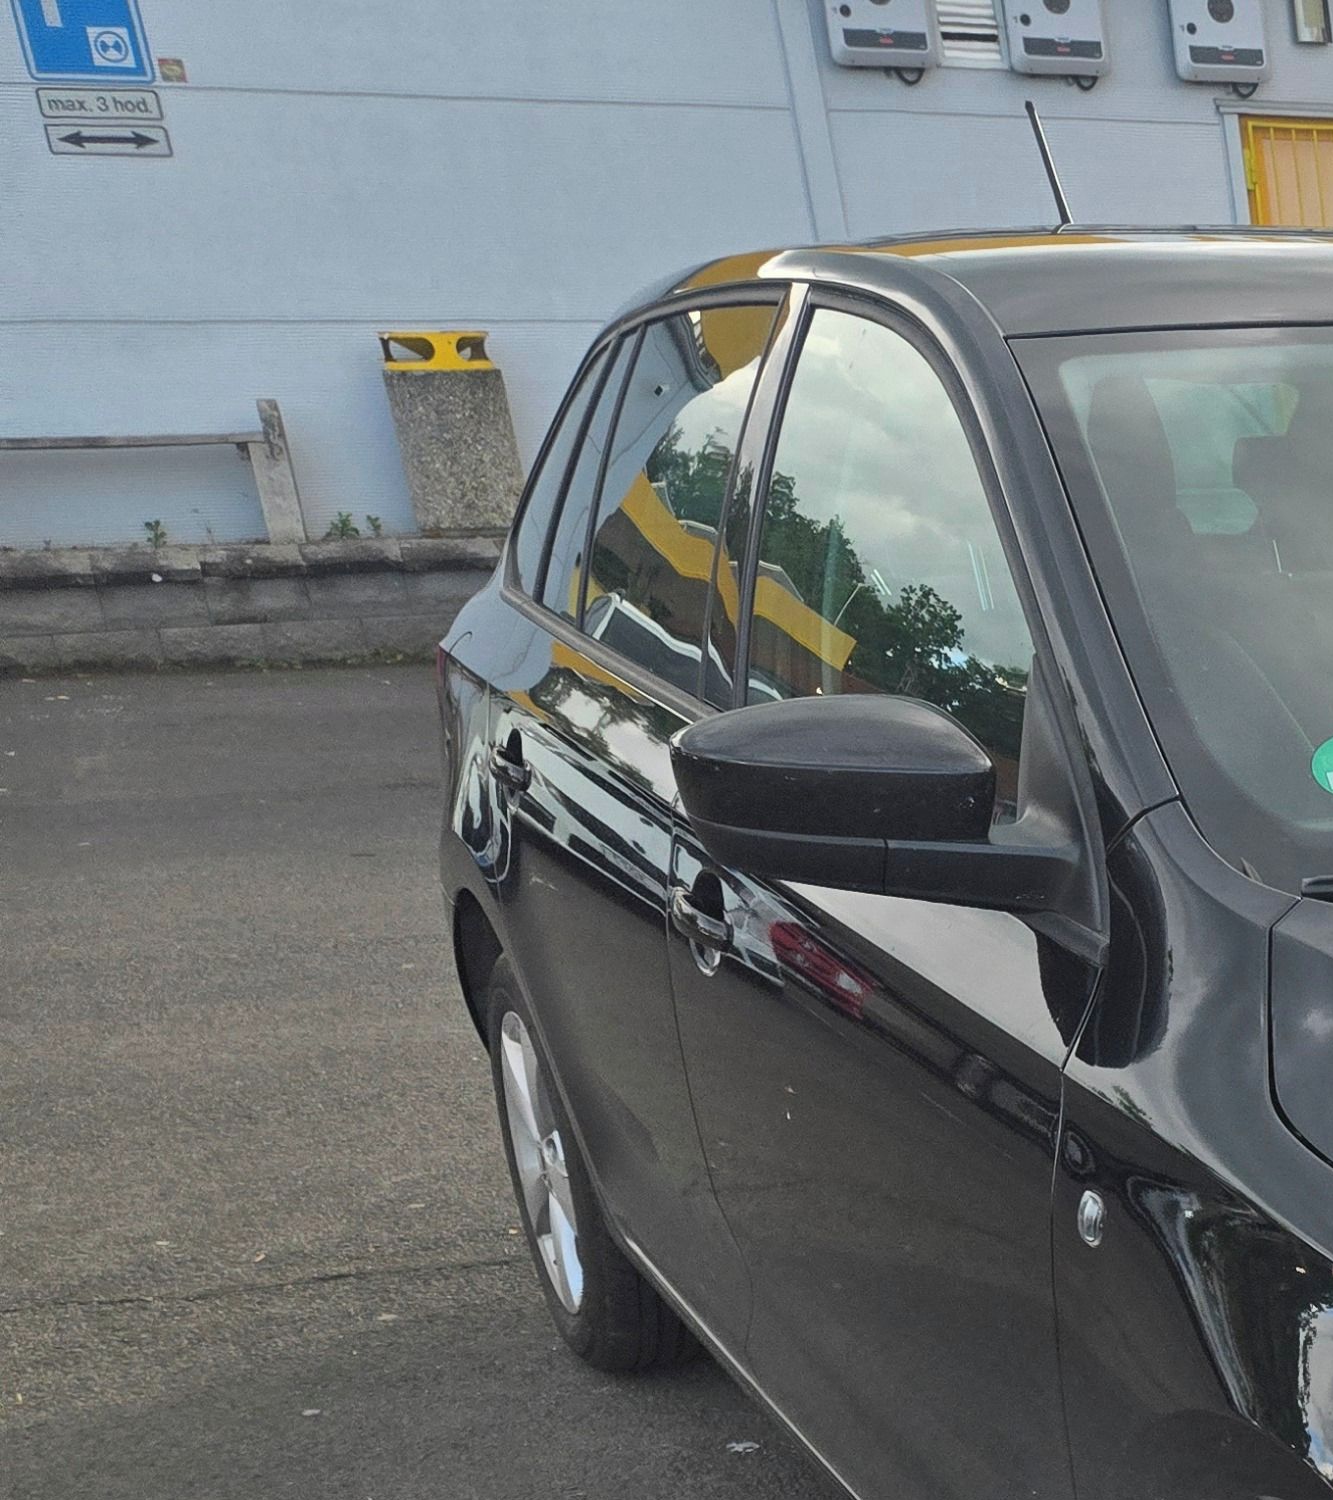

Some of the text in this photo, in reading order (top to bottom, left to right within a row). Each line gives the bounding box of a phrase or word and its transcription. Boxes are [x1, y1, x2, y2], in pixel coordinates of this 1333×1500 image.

[47, 96, 153, 114] max. 3 hod.
